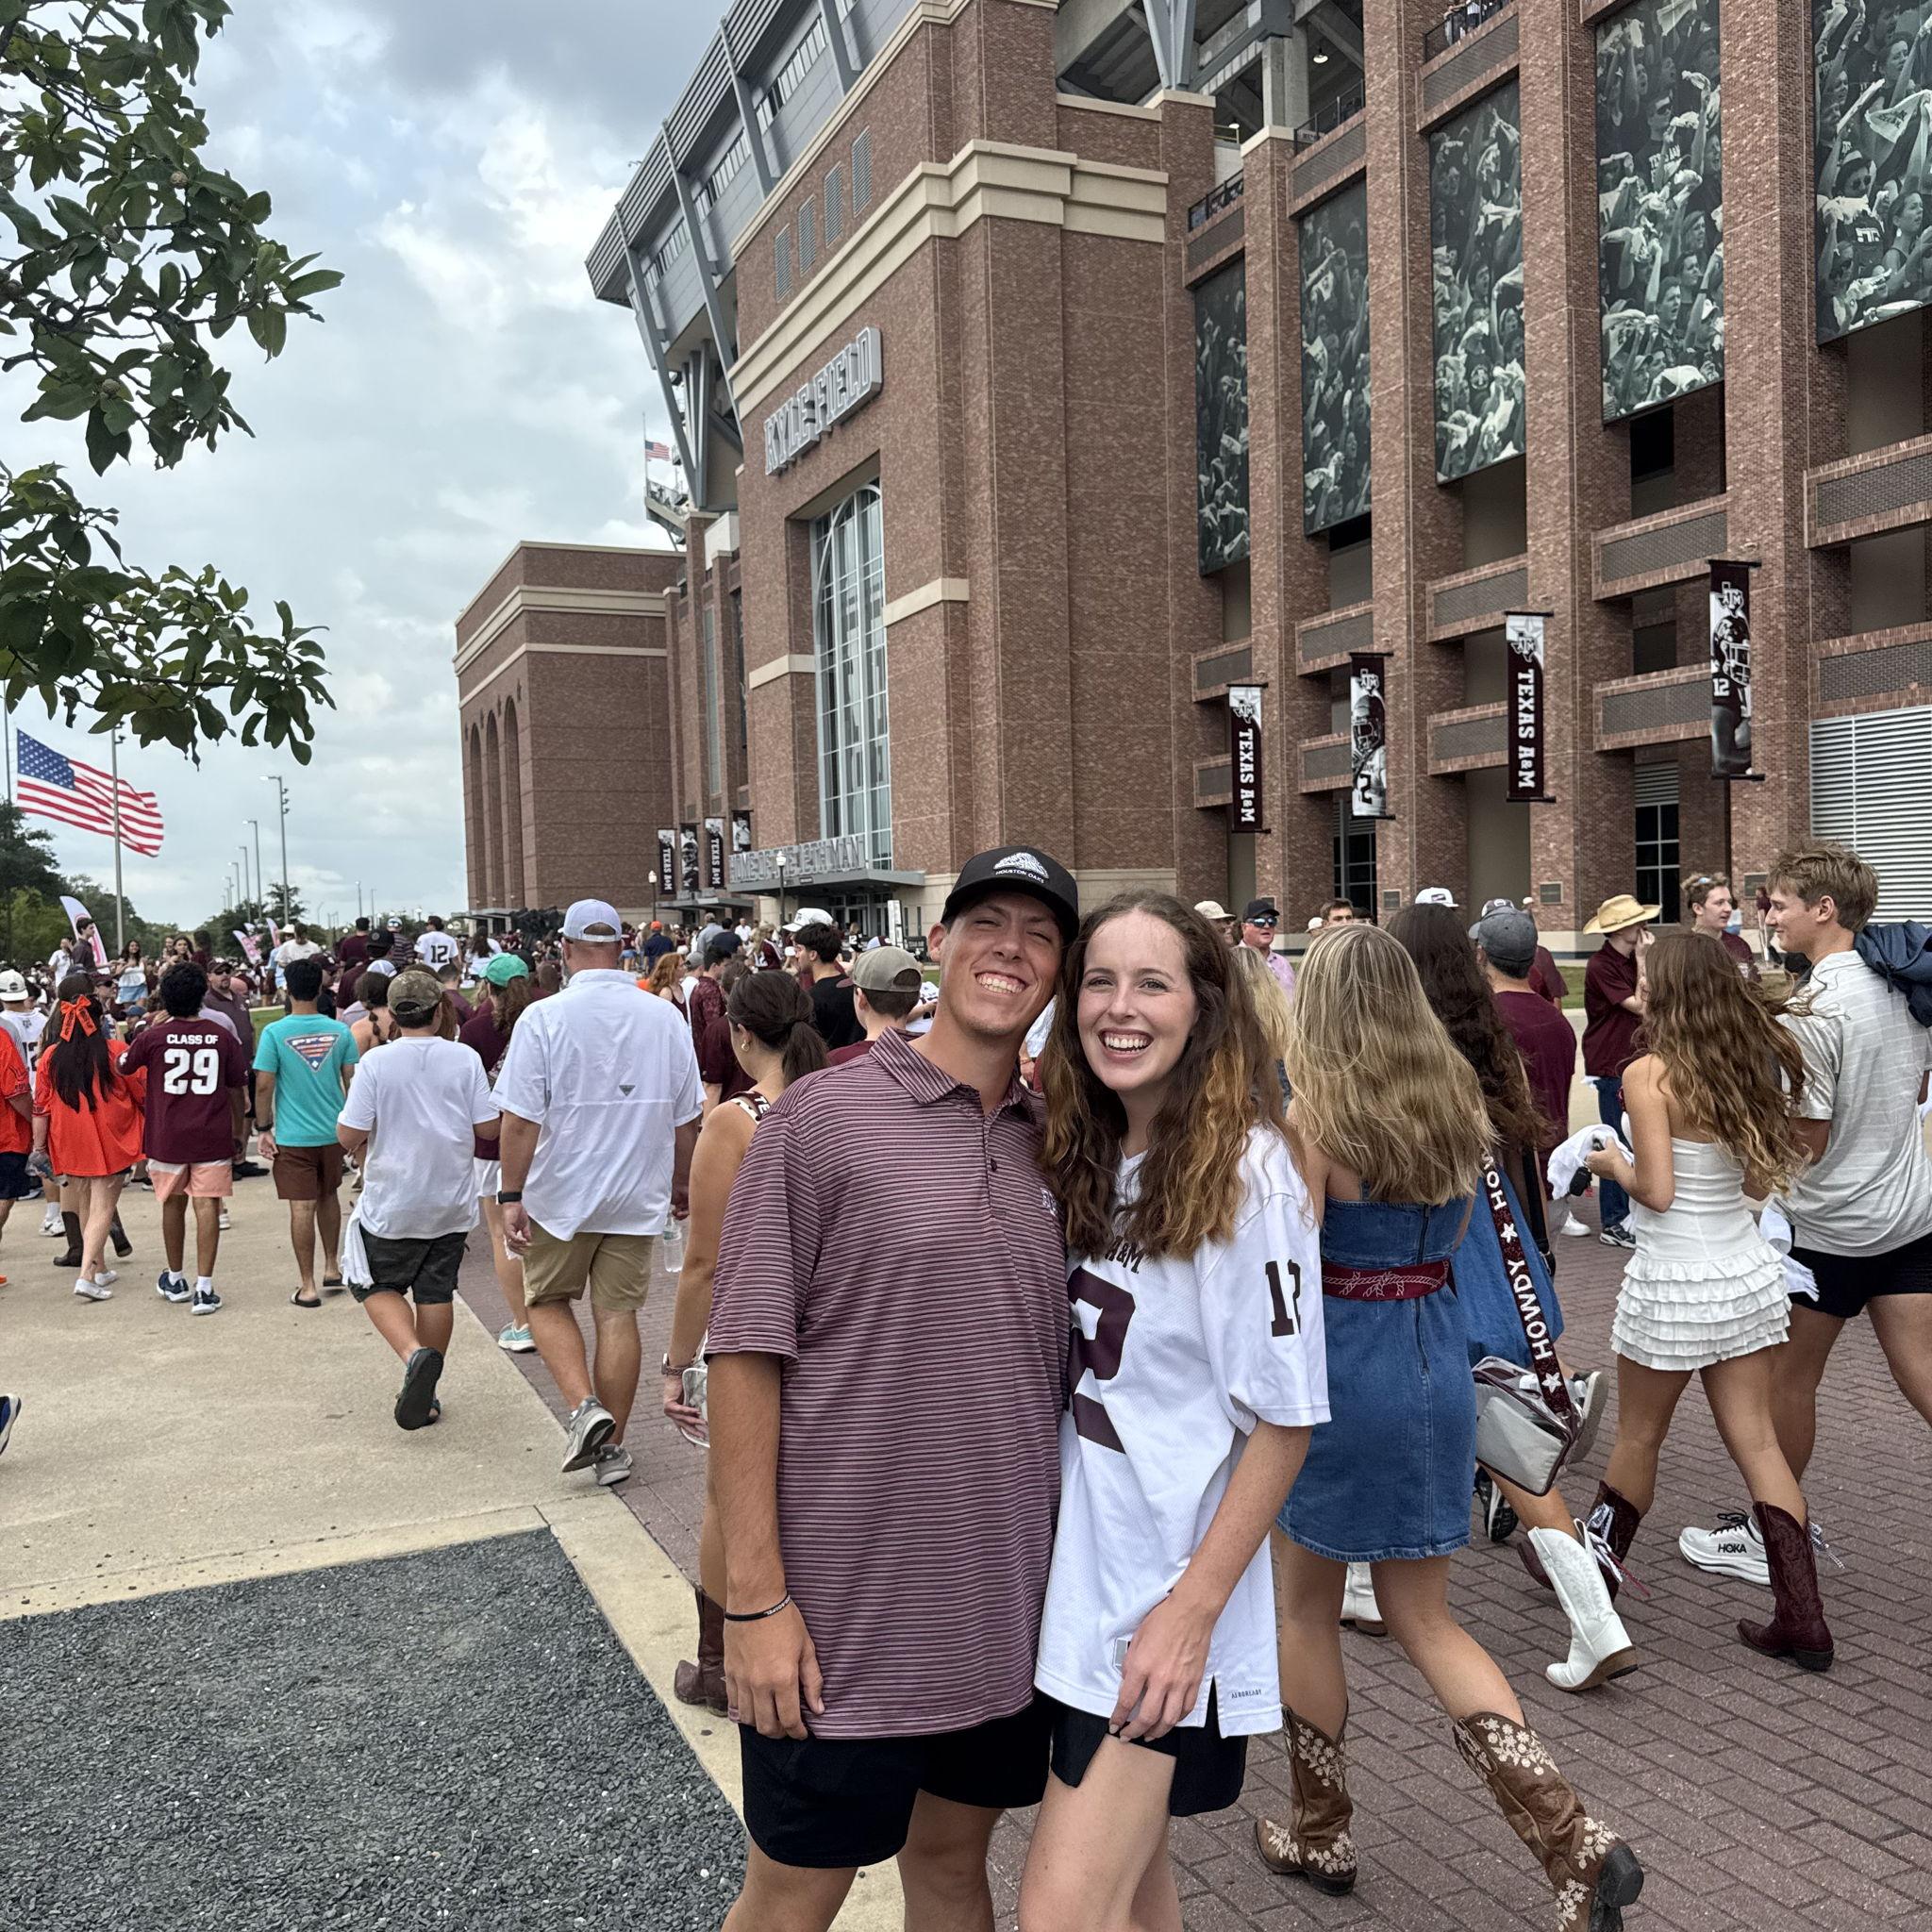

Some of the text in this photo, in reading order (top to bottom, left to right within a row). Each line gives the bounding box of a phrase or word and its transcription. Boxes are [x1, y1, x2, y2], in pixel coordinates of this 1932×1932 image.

[764, 326, 882, 475] KYLE FIELD
[1712, 678, 1730, 696] 12
[1517, 669, 1536, 788] TEXAS A&M
[1239, 728, 1256, 823] TEXAS A&M
[662, 848, 673, 891] TEXAS A&M
[710, 838, 722, 885] TEXAS A&M
[827, 834, 866, 872] MAN
[1027, 873, 1044, 884] OAKS
[431, 944, 448, 963] 12
[167, 1034, 219, 1045] CLASS OF
[164, 1048, 220, 1095] 29
[1507, 1259, 1555, 1360] HOWDY
[1717, 1542, 1747, 1554] HOKA
